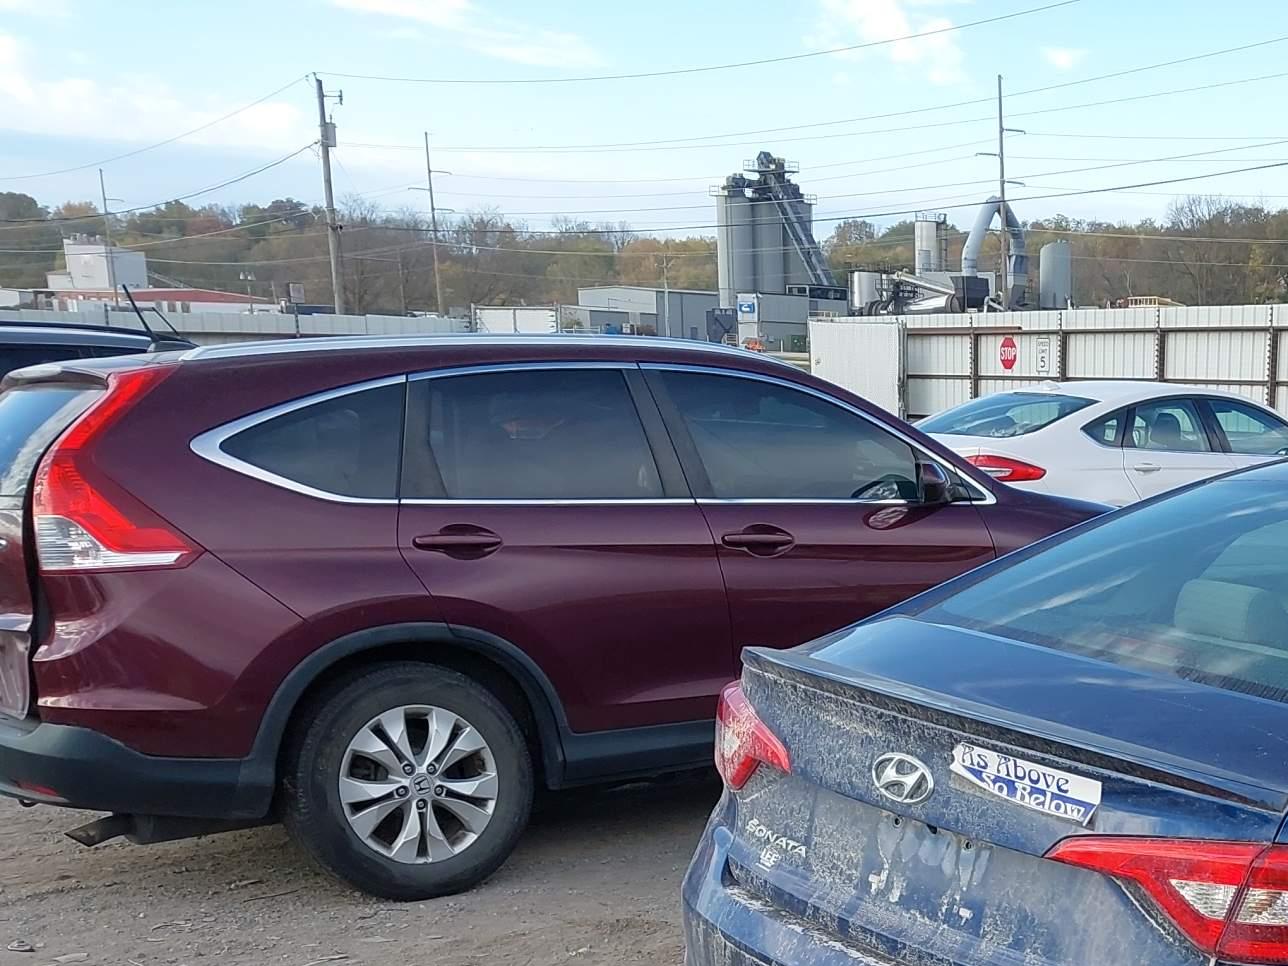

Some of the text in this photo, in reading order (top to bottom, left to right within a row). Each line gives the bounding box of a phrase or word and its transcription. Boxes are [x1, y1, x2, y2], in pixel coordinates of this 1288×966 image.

[1000, 347, 1016, 360] STOP
[1040, 356, 1046, 368] 5
[961, 743, 1070, 794] As Above
[1014, 782, 1086, 822] Below
[745, 818, 807, 858] SONATA
